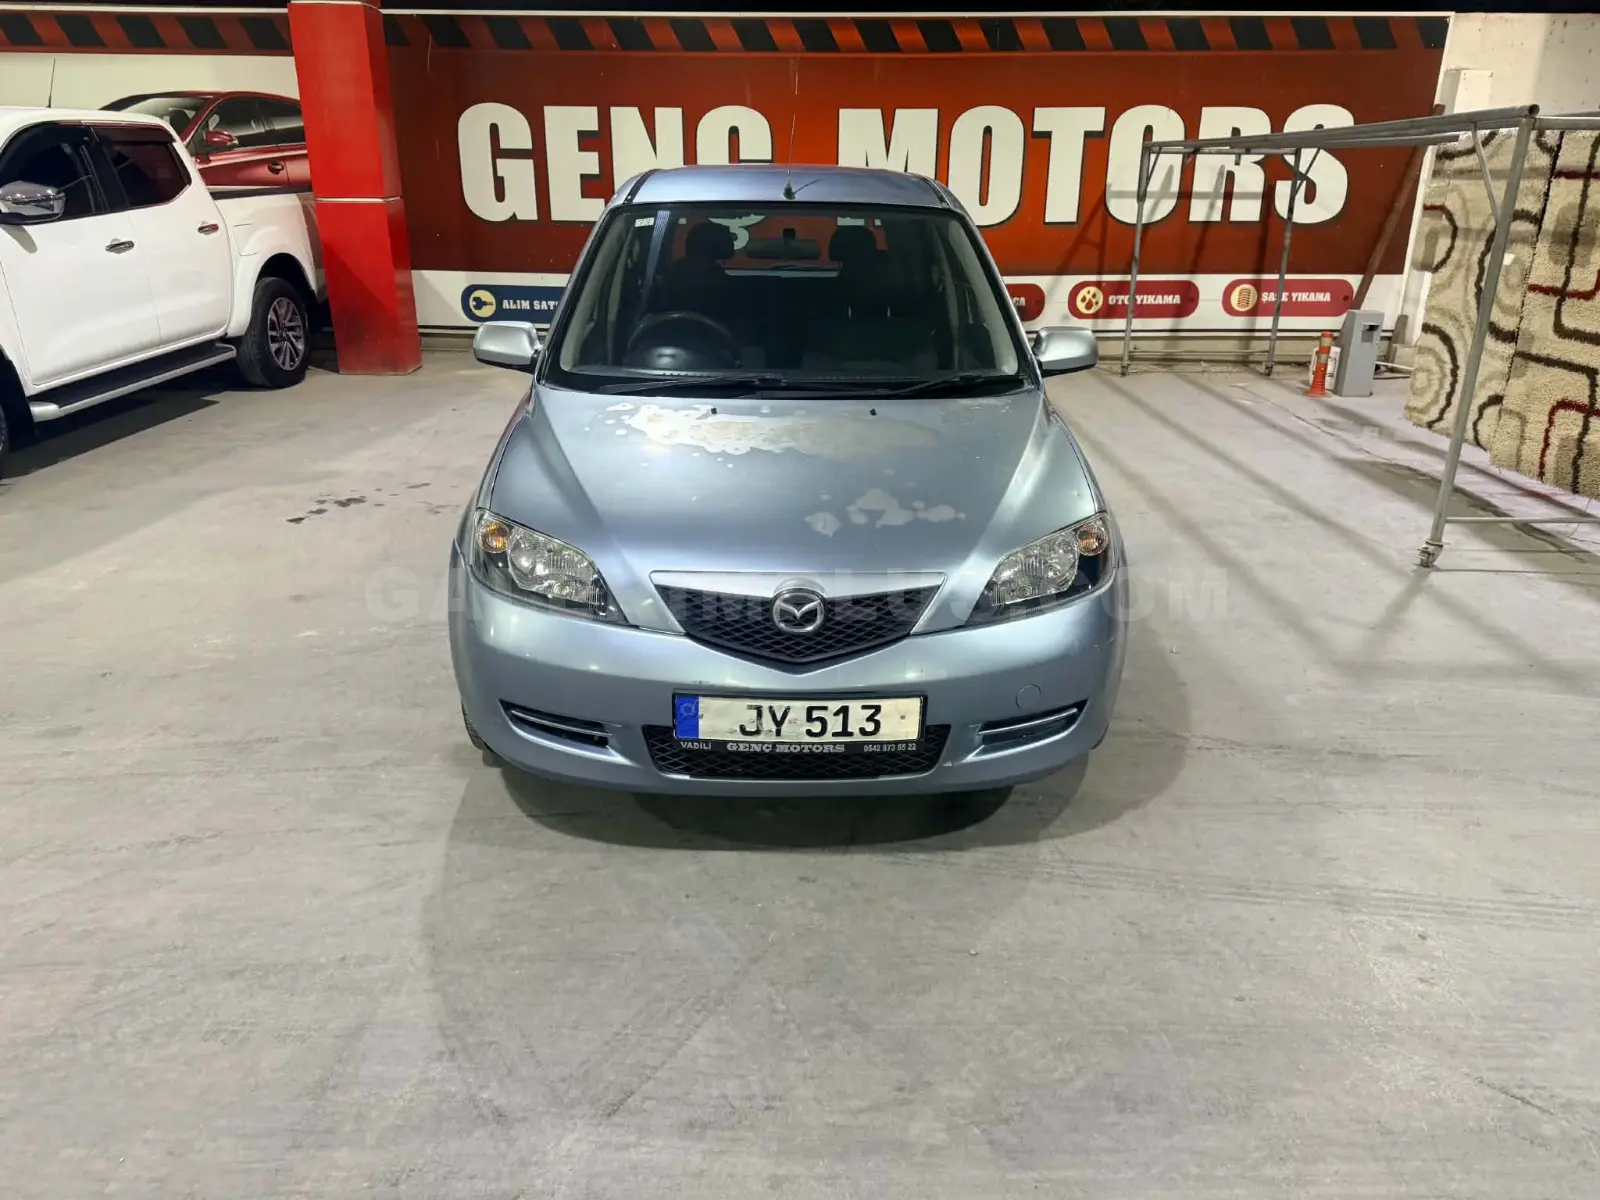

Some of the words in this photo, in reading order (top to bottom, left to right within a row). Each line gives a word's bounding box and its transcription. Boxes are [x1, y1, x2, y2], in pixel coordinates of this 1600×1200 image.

[836, 103, 1355, 224] MOTORS
[1108, 294, 1132, 306] OTO
[1135, 294, 1182, 305] YIKAMA
[1291, 292, 1331, 303] YIKAMA
[502, 299, 530, 310] ALIM
[533, 300, 558, 311] SAT
[738, 704, 792, 738] JY
[804, 704, 882, 738] 513
[775, 743, 845, 753] MOTORS
[907, 742, 917, 751] 22
